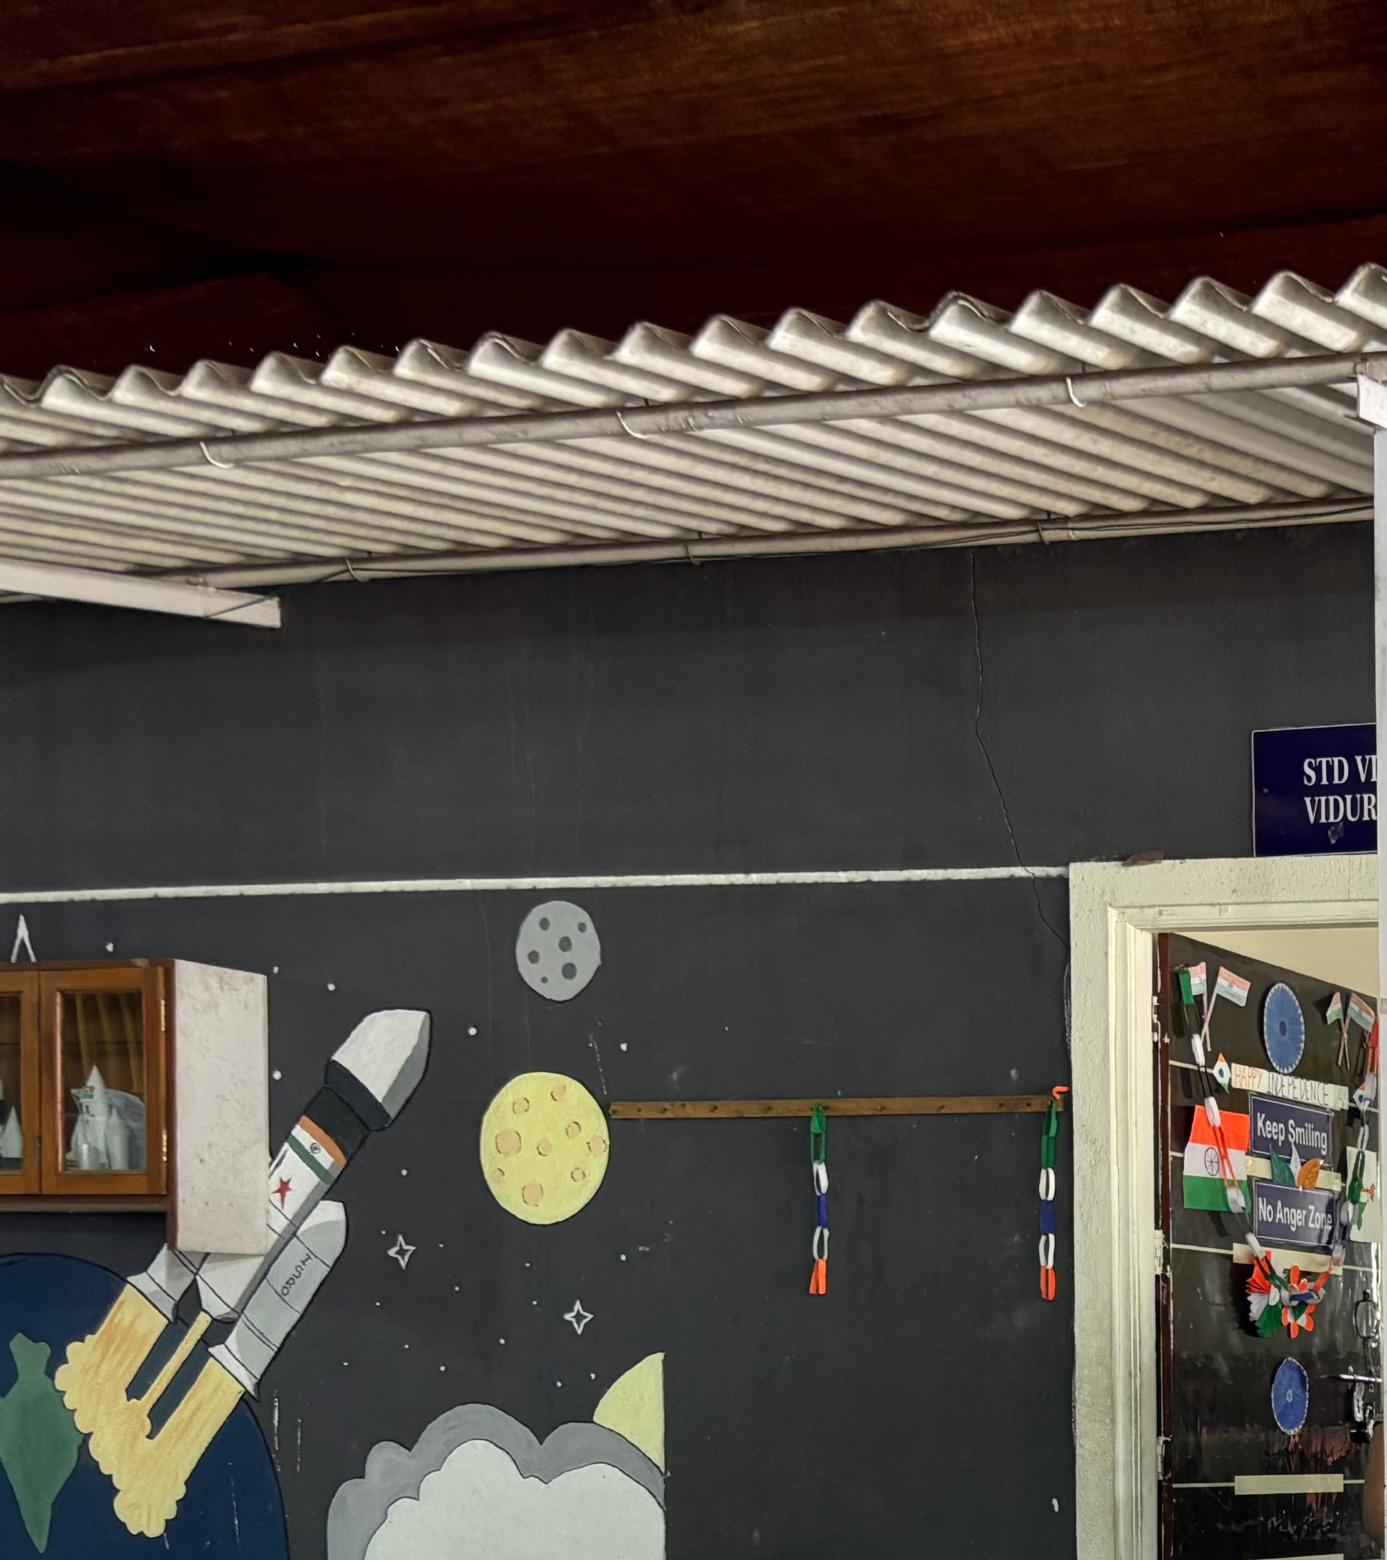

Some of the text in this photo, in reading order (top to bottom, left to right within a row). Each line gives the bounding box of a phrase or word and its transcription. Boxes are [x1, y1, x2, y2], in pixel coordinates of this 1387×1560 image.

[1303, 757, 1349, 786] STD
[1257, 1113, 1327, 1154] Keep Smiling
[1258, 1197, 1333, 1231] No Anger Zone
[281, 1253, 312, 1296] ISRO
